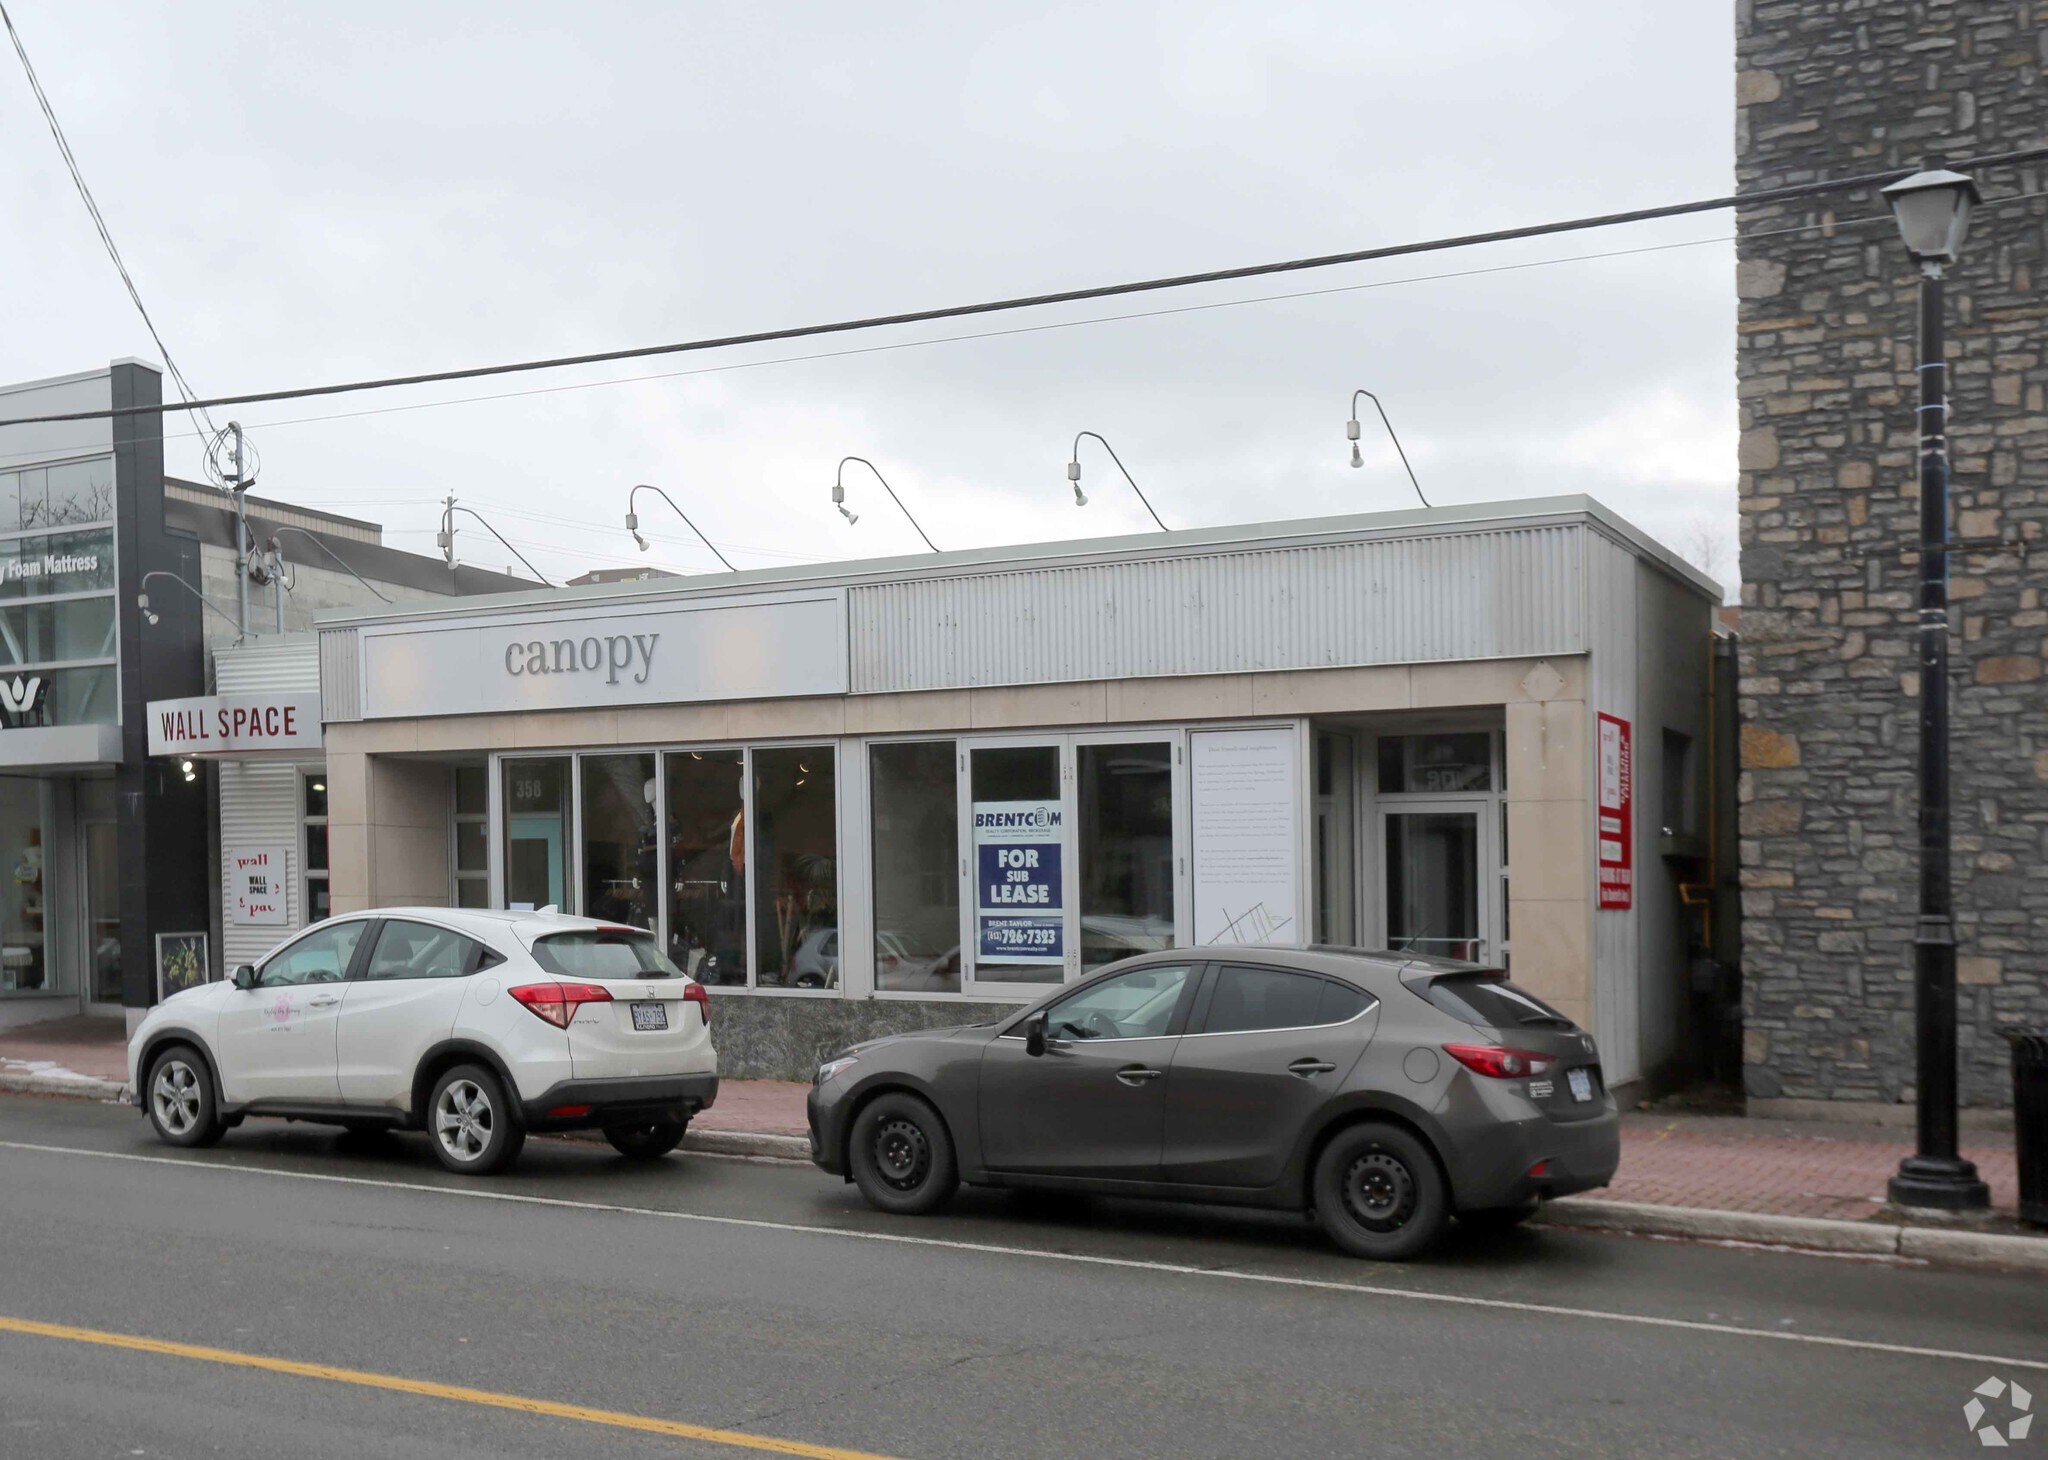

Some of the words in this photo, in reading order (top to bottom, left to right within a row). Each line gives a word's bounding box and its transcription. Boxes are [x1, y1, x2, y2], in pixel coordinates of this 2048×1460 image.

[8, 559, 40, 578] Foam
[44, 554, 98, 574] Mattress
[505, 633, 660, 685] canopy
[161, 710, 209, 741] WALL
[218, 706, 297, 738] SPACE
[516, 780, 541, 798] 358
[975, 807, 1061, 827] BRENTCOM
[998, 849, 1039, 868] FOR
[249, 876, 267, 885] WALL
[1006, 870, 1029, 882] SUB
[249, 886, 267, 895] SPACE
[990, 884, 1049, 903] LEASE
